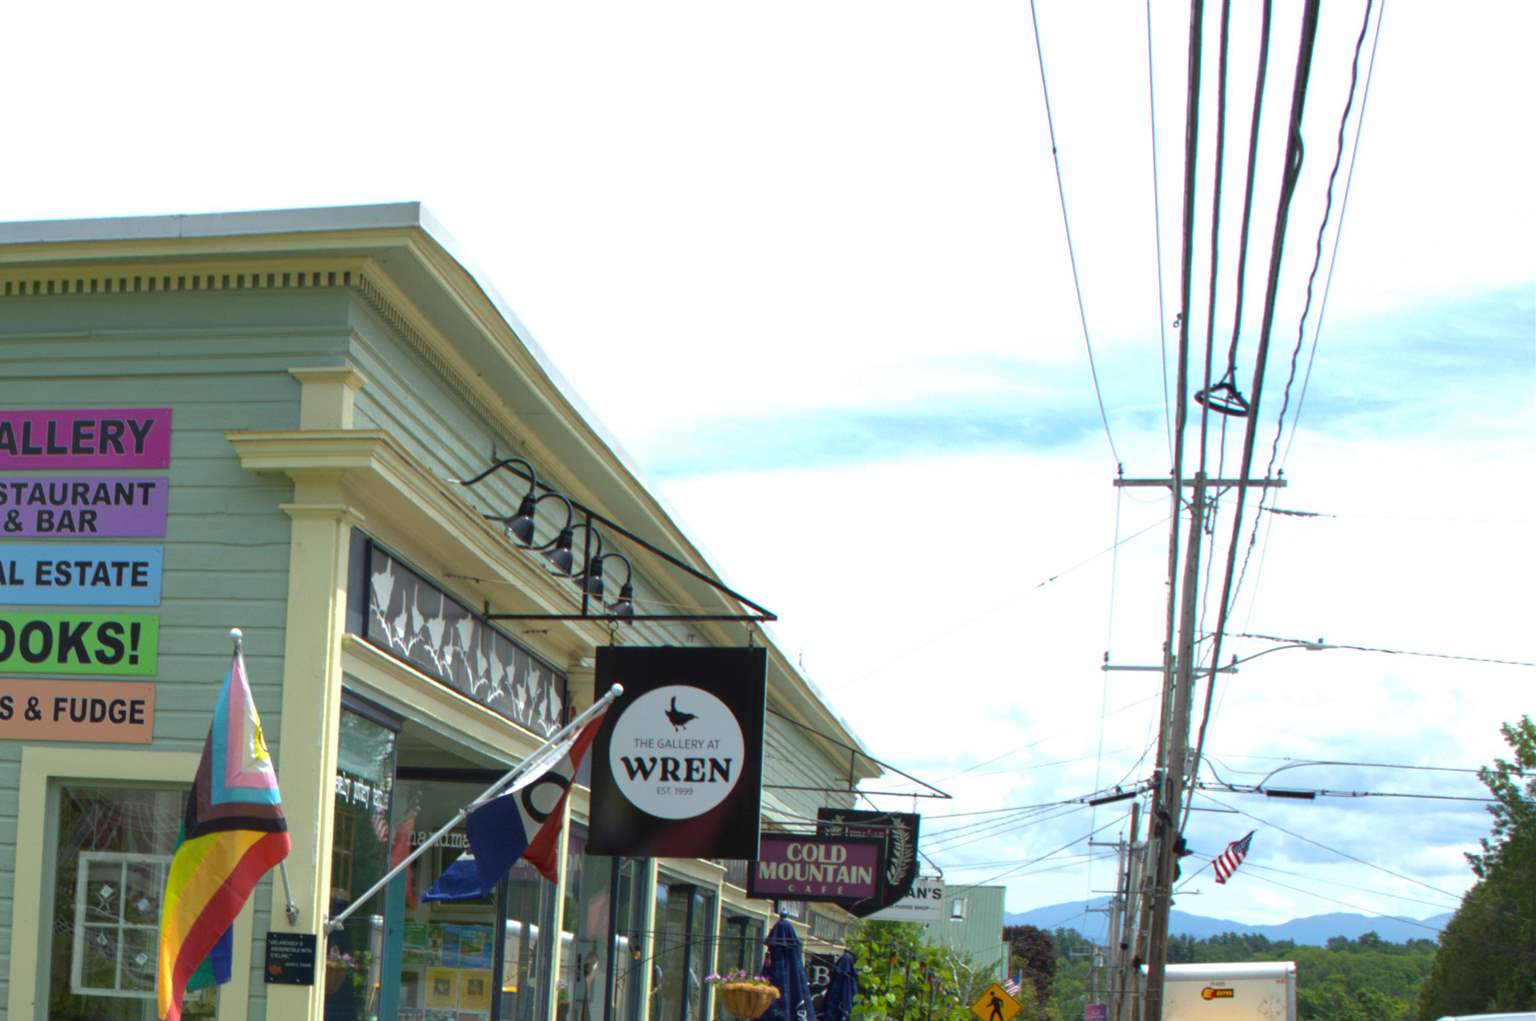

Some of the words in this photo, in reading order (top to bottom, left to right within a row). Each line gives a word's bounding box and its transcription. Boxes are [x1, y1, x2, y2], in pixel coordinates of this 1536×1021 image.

[3, 510, 23, 532] &
[36, 510, 97, 533] BAR
[35, 560, 149, 587] ESTATE
[24, 696, 42, 721] &
[53, 697, 145, 724] FUDGE
[634, 738, 654, 749] THE
[656, 738, 704, 749] GALLERY
[707, 739, 720, 749] AT
[620, 756, 732, 783] WREN
[786, 842, 847, 864] COLD
[758, 861, 873, 885] MOUNTAIN
